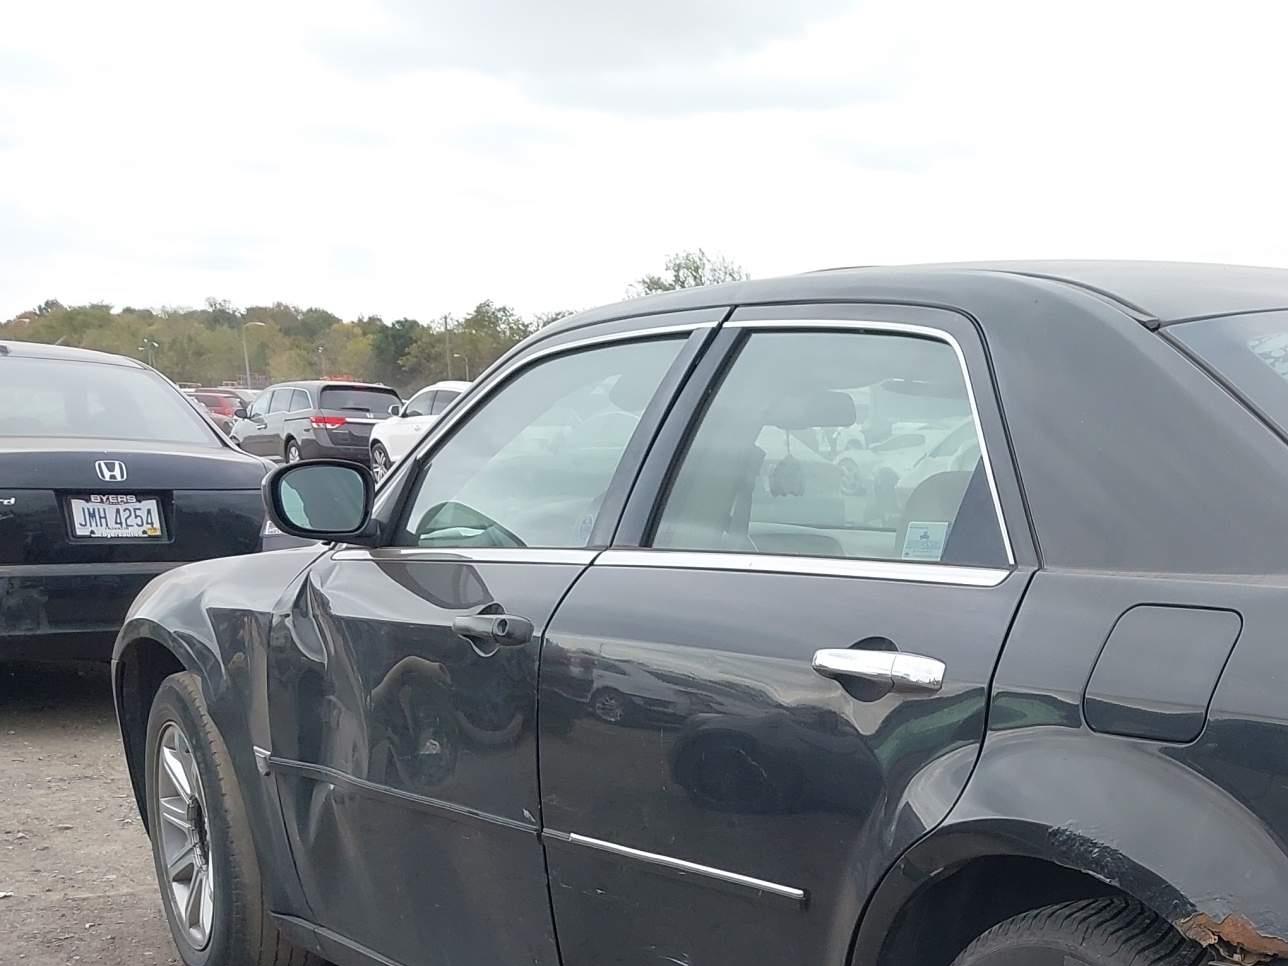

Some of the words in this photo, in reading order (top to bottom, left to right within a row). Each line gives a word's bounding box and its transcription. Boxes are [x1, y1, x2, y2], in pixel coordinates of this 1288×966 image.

[90, 494, 137, 503] BYERS
[79, 506, 109, 529] JMH
[114, 507, 155, 530] 4254
